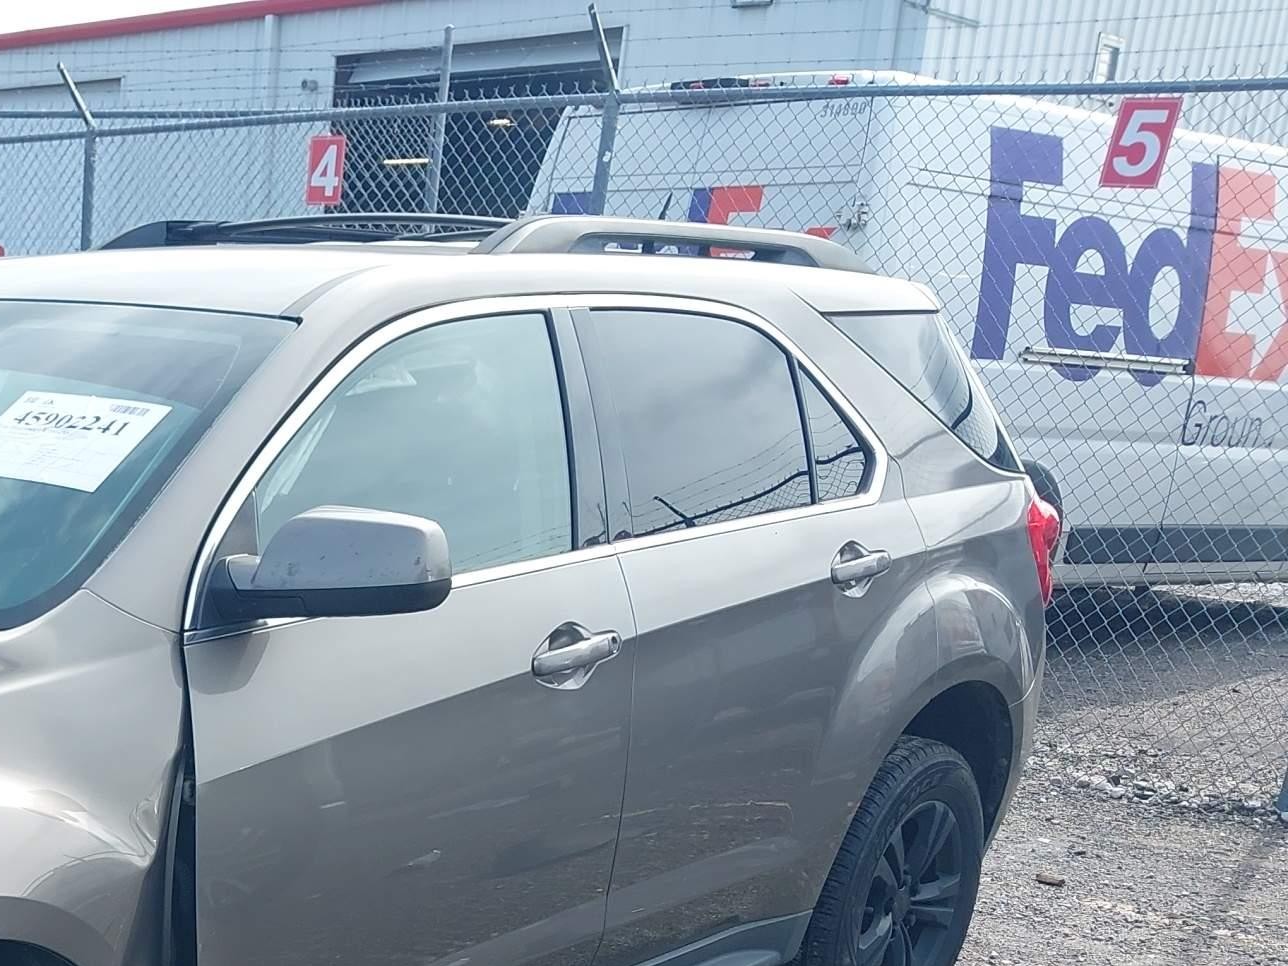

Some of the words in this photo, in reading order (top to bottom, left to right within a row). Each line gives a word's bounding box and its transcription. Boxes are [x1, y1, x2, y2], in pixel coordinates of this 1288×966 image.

[1112, 109, 1169, 178] 5
[310, 144, 339, 197] 4
[13, 410, 130, 436] 45902241
